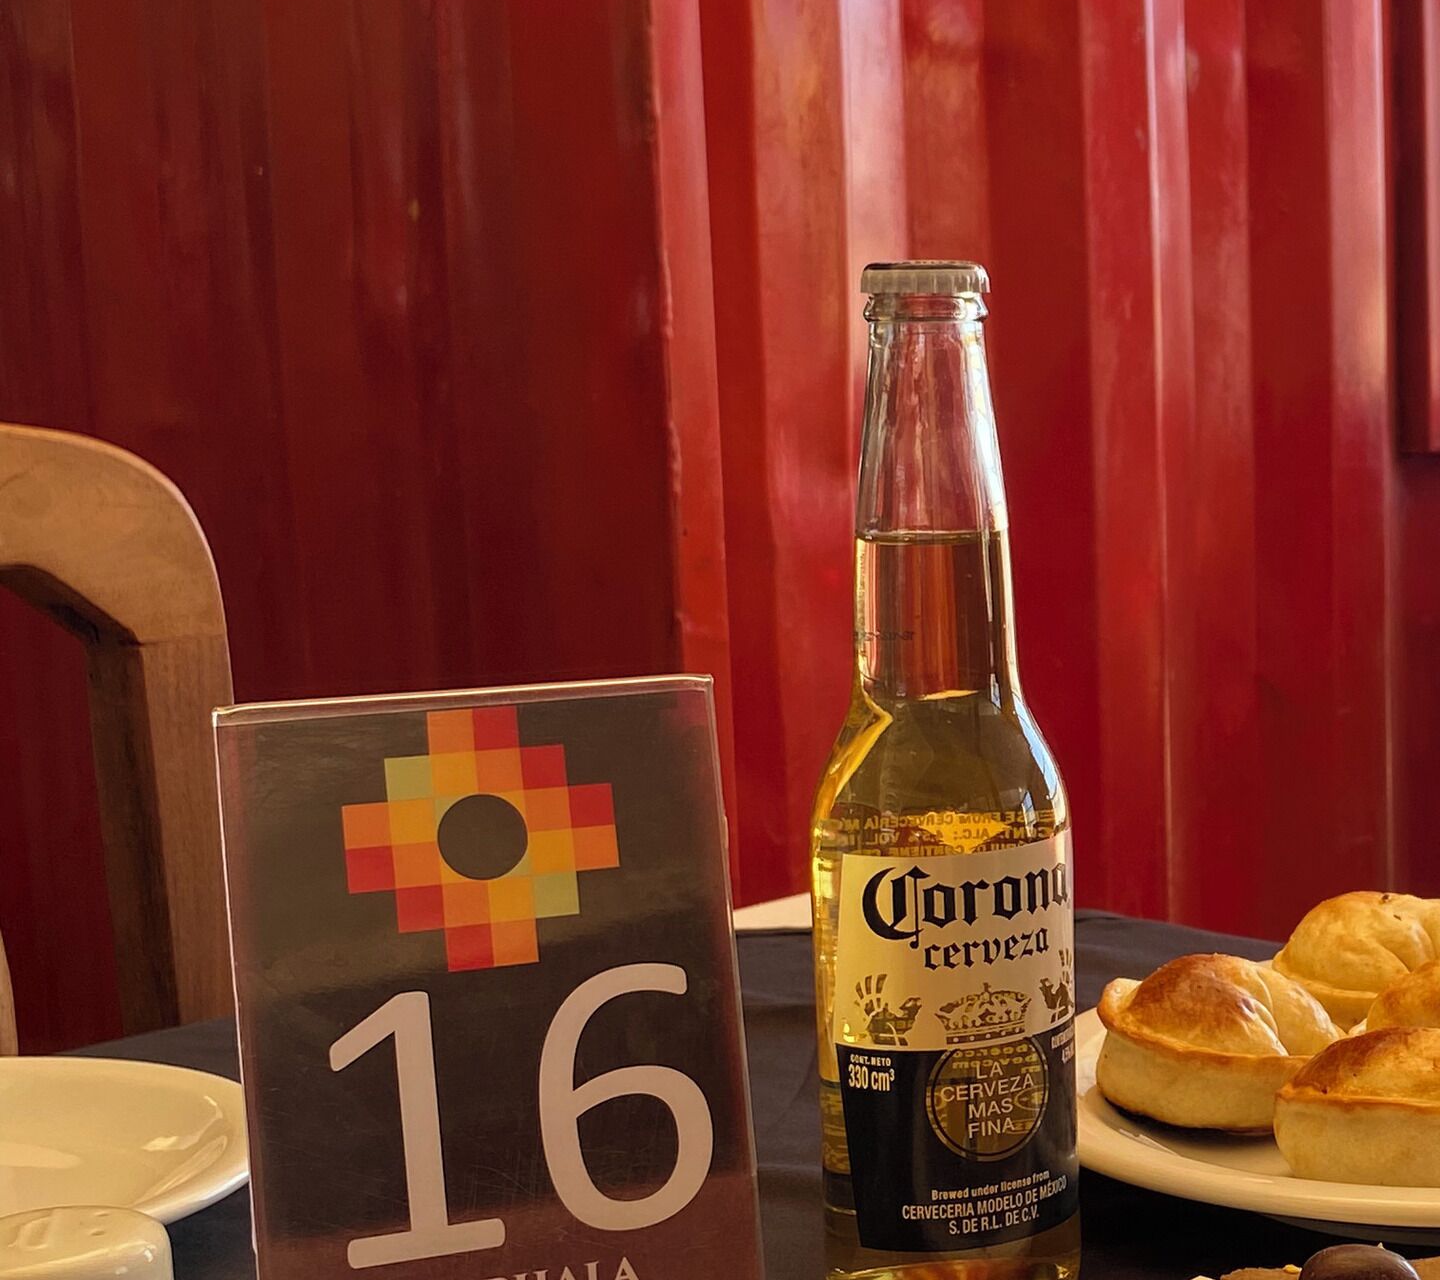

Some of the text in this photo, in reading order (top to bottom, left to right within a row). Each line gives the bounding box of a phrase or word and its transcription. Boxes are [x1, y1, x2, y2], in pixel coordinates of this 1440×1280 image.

[862, 863, 1068, 949] Corona
[924, 927, 1049, 971] cerveza
[848, 1063, 869, 1090] 330
[976, 1061, 1003, 1080] LA
[940, 1073, 1034, 1102] CERVEZA
[329, 963, 713, 1269] 16
[968, 1097, 1014, 1119] MAS
[968, 1117, 1015, 1139] FINA
[931, 1170, 1050, 1201] Brewed under license from
[902, 1204, 975, 1219] CERVECERIA
[977, 1192, 1023, 1215] MODELO
[1025, 1188, 1038, 1204] DE
[949, 1204, 1040, 1235] S. DE R.L. DE C.V.
